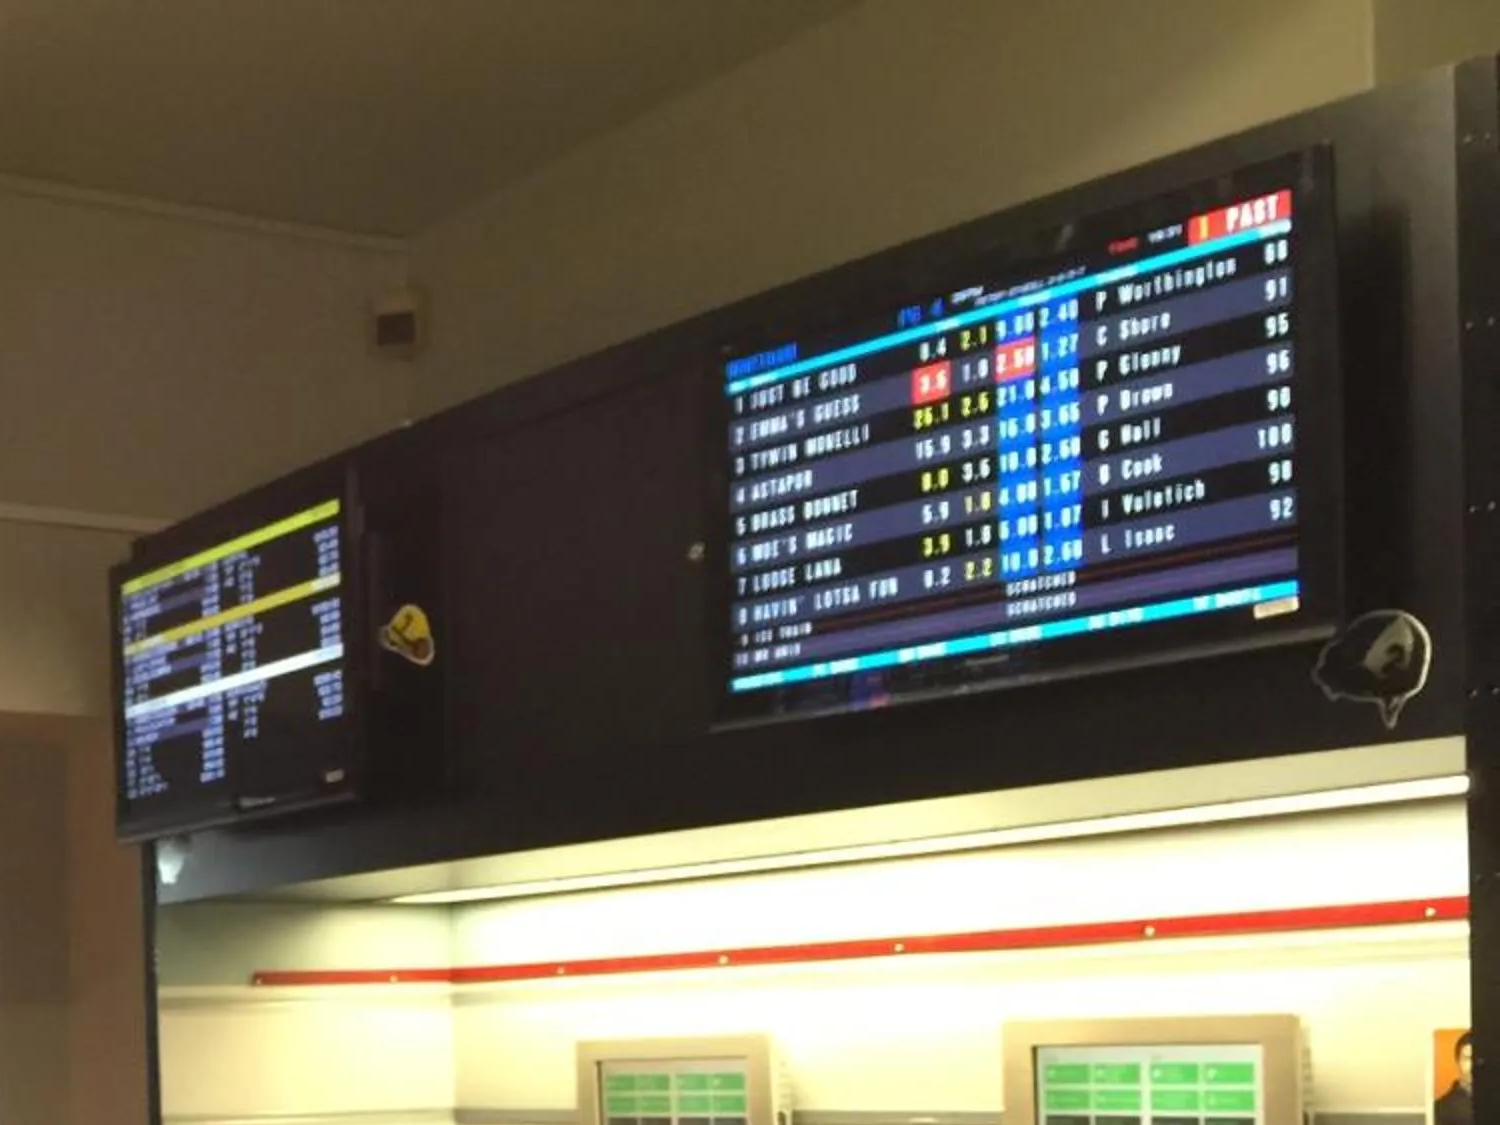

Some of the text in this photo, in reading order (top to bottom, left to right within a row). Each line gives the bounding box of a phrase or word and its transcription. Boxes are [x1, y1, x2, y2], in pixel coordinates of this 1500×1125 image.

[1226, 193, 1279, 233] PAST
[1118, 257, 1237, 305] Worthington
[1264, 276, 1288, 301] 91
[1269, 496, 1294, 521] 92
